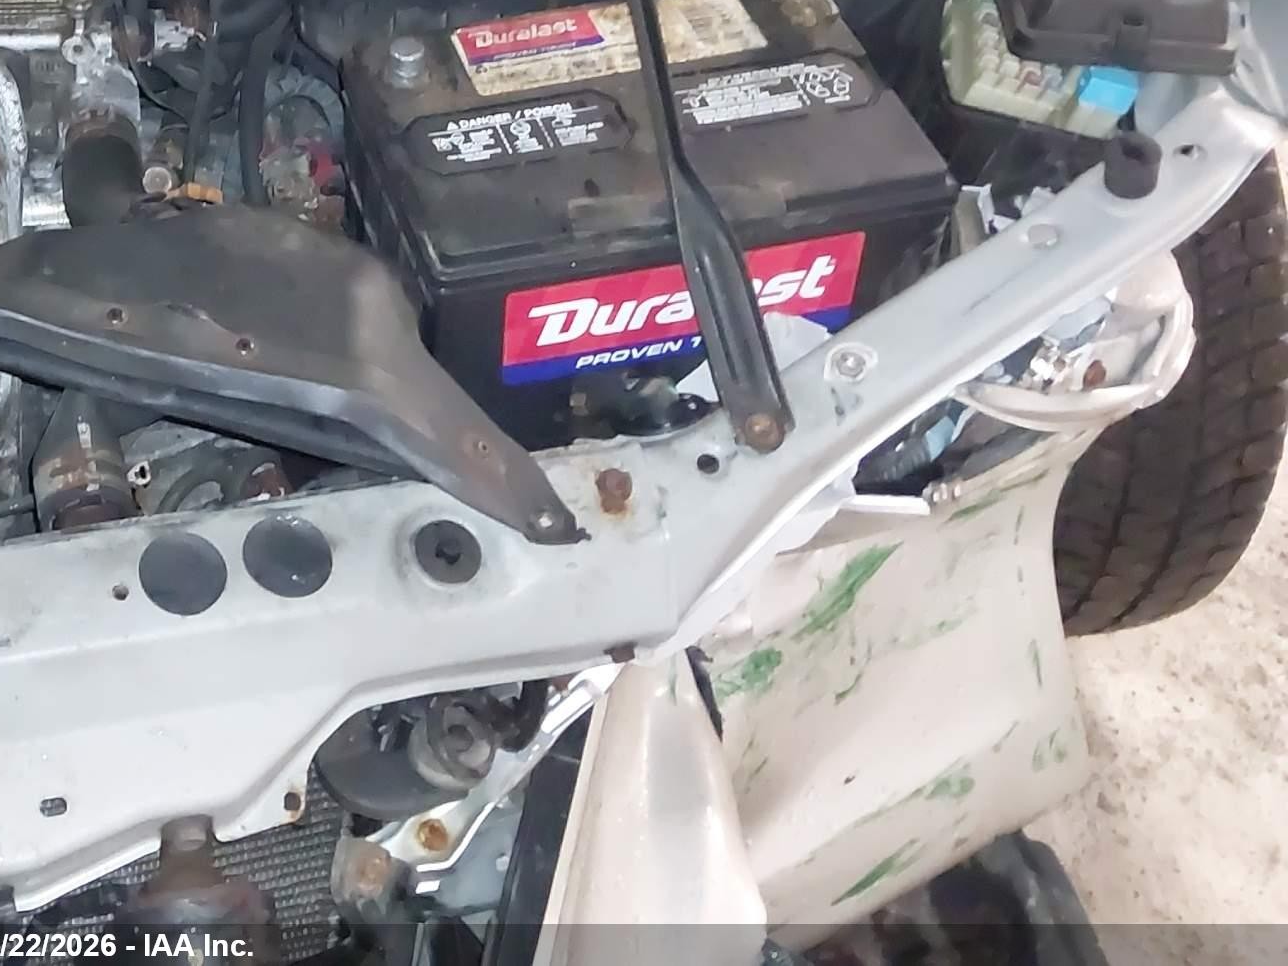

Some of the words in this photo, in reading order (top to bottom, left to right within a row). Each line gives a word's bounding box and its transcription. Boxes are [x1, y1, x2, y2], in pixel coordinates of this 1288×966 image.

[467, 17, 578, 49] Duralast
[459, 112, 512, 127] DANGER
[528, 254, 837, 347] Durast
[575, 339, 683, 369] PROVEN
